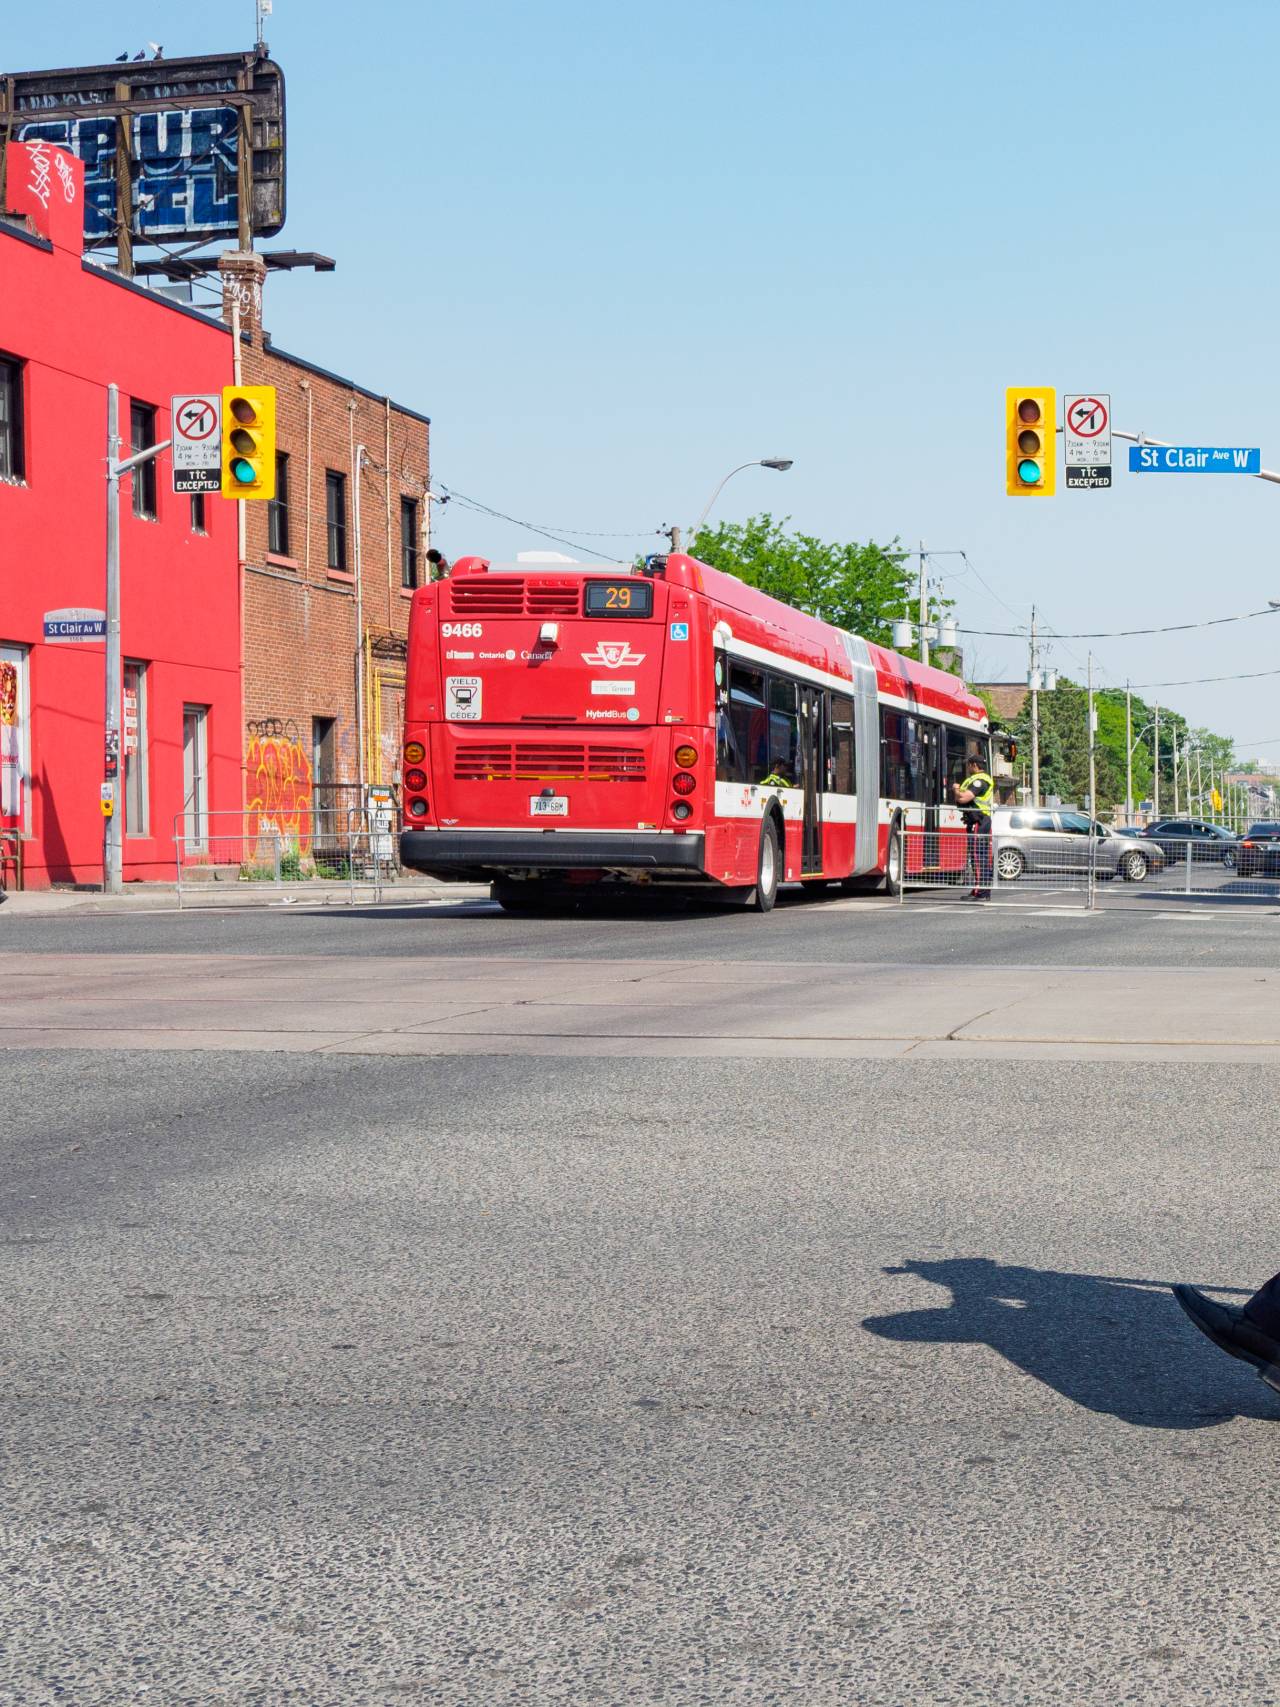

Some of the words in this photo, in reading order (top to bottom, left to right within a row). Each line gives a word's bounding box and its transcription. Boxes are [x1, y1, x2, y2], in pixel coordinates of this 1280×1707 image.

[1140, 448, 1158, 467] St
[1165, 448, 1209, 467] Clair
[1212, 450, 1229, 460] Ave
[1233, 450, 1249, 467] W
[189, 471, 207, 480] TTC
[1081, 469, 1097, 477] TTC
[176, 481, 219, 490] EXCEPTED
[1068, 478, 1109, 486] EXCEPTED
[606, 587, 631, 608] 29
[48, 624, 58, 634] St
[60, 623, 82, 633] Clair
[84, 625, 93, 633] Av
[94, 622, 102, 632] W
[442, 623, 482, 637] 9466
